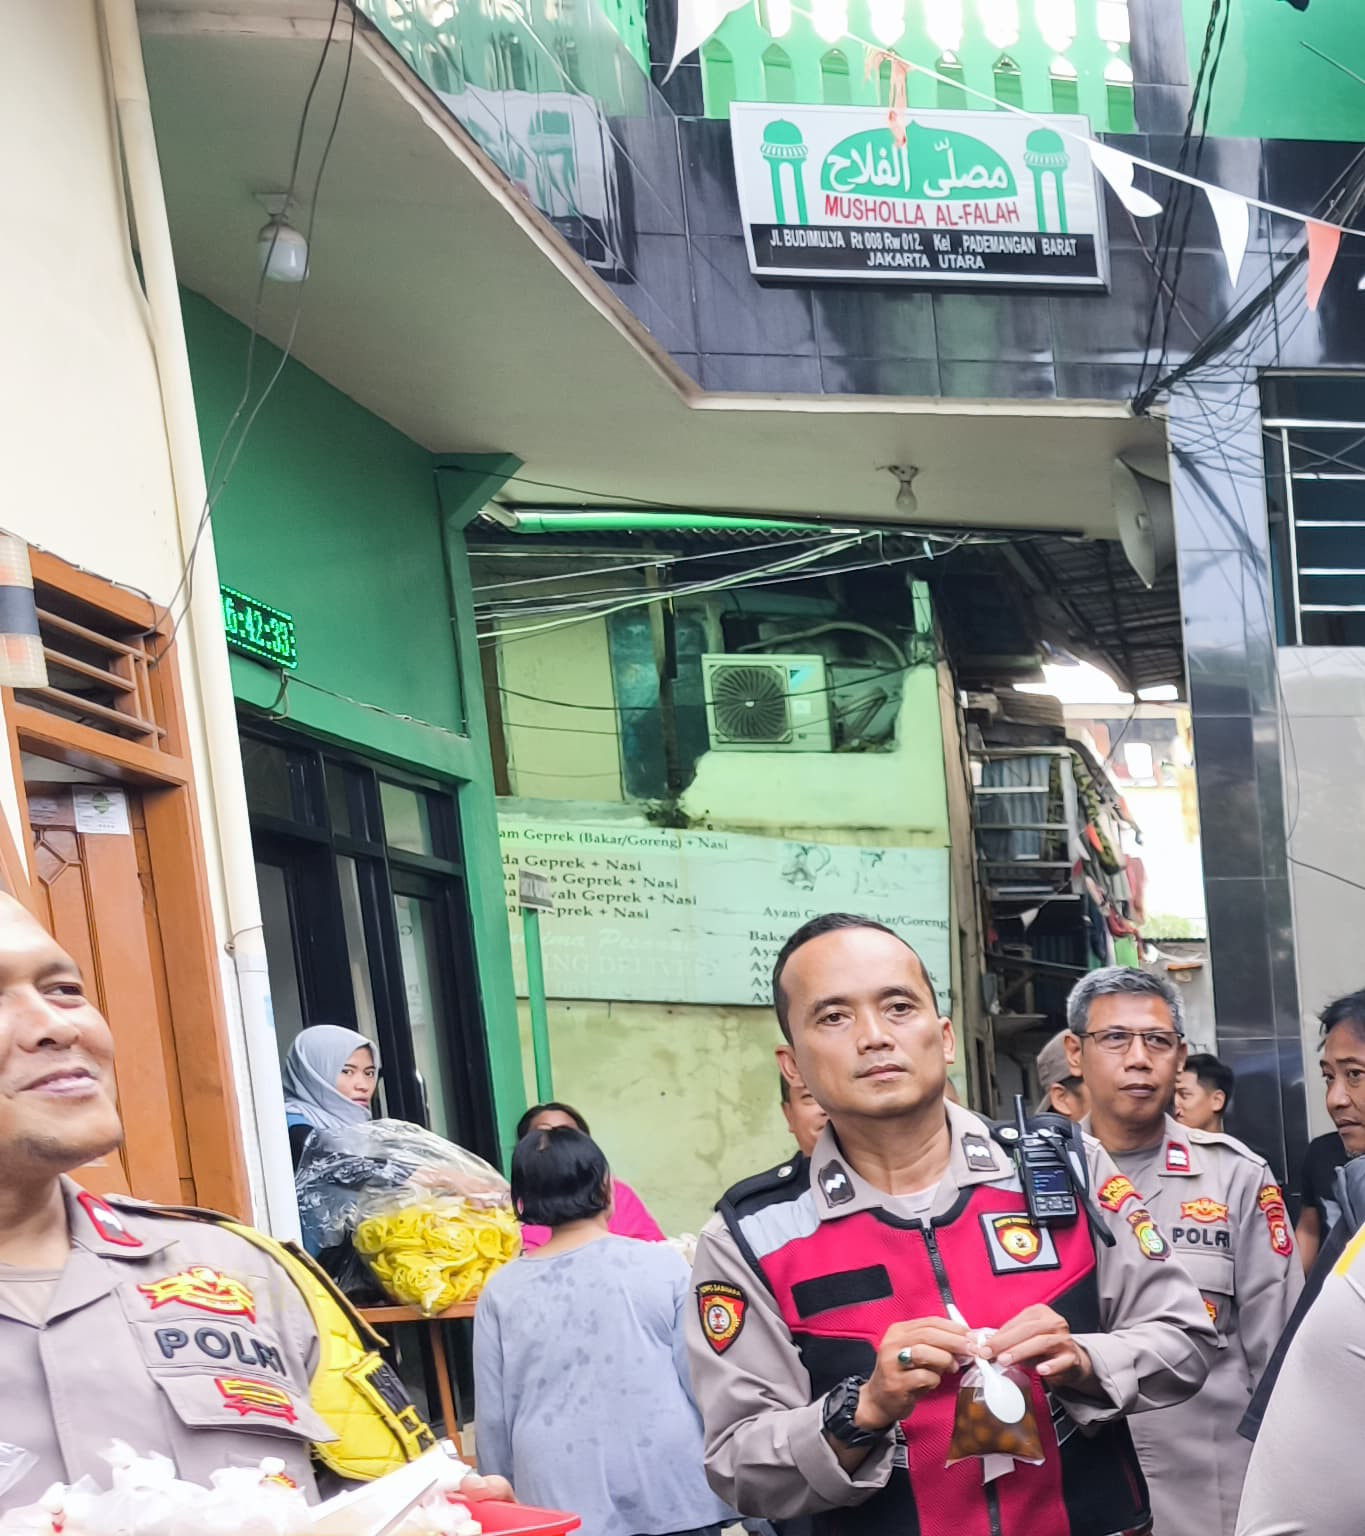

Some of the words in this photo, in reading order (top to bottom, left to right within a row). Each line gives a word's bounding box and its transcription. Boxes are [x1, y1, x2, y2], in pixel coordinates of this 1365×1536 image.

[824, 195, 927, 227] MUSHOLLA
[936, 201, 1021, 227] AL-FALAH
[783, 229, 846, 248] BUDIMULYA
[1041, 237, 1077, 256] BARAT
[867, 251, 930, 268] JAKARTA
[938, 254, 985, 270] UTARA
[523, 830, 575, 844] Geprek
[578, 832, 683, 850] (Bakar/Goreng)
[698, 836, 729, 850] Nasi
[524, 855, 585, 871] Geprek
[606, 859, 642, 872] Nasi
[562, 873, 623, 889] Geprek
[643, 877, 678, 889] Nasi
[582, 890, 642, 905] Geprek
[662, 893, 697, 906] Nasi
[614, 907, 649, 920] Nasi
[749, 930, 788, 942] Baks
[750, 946, 779, 958] Aya
[1172, 1227, 1231, 1248] POLRI
[154, 1327, 287, 1377] POLRI
